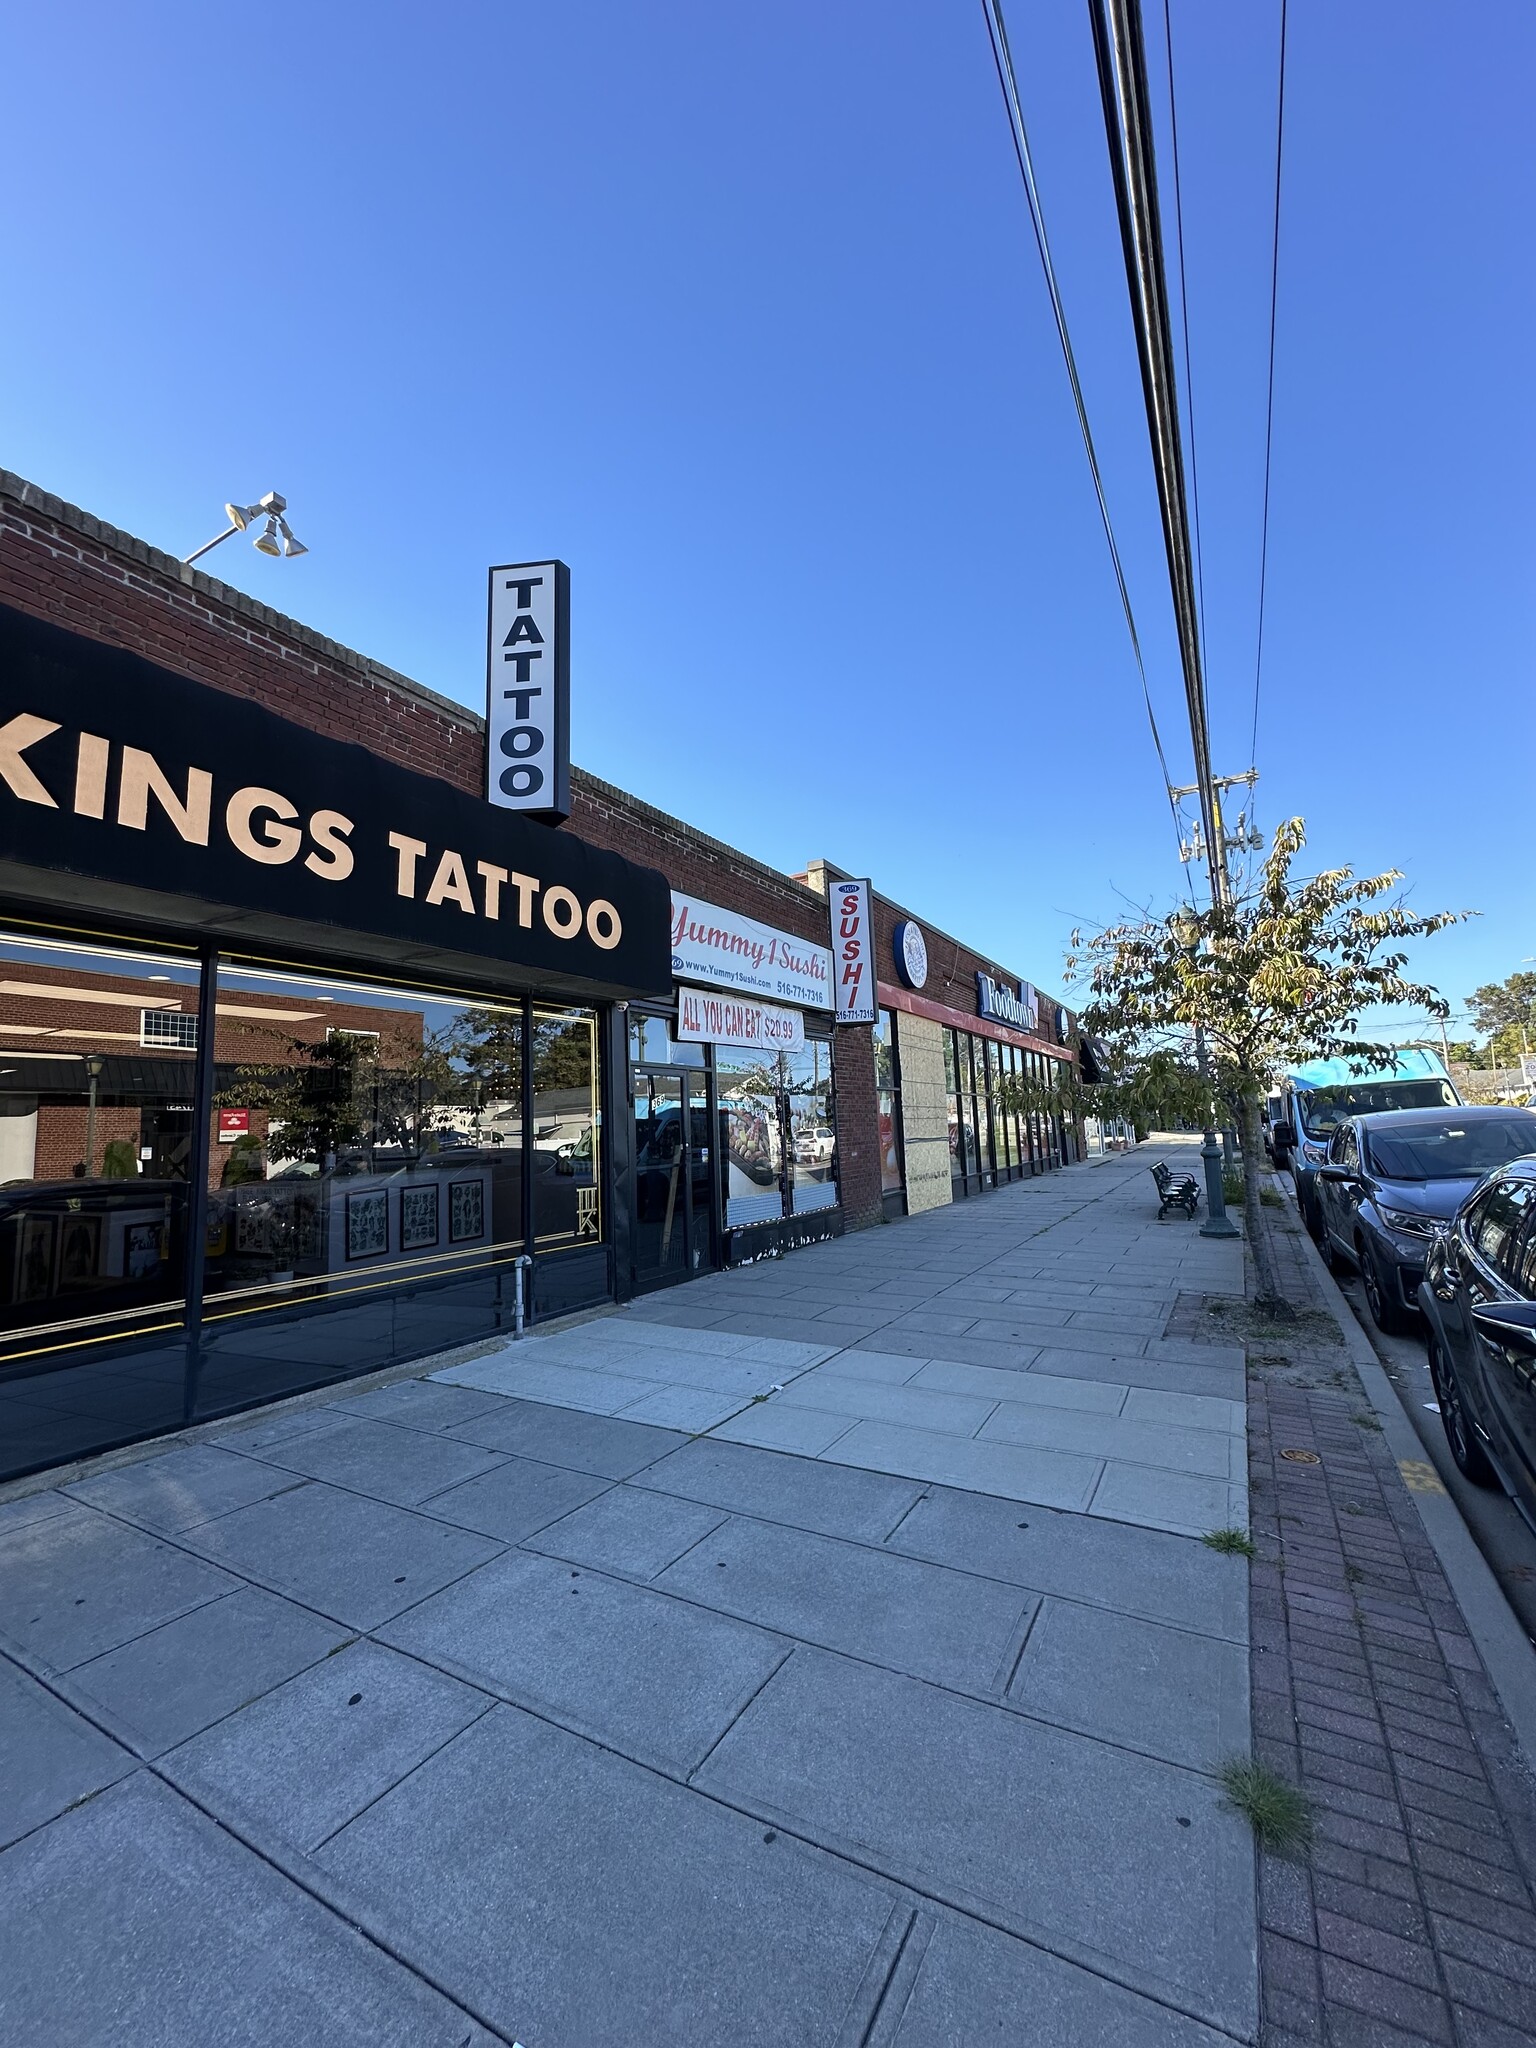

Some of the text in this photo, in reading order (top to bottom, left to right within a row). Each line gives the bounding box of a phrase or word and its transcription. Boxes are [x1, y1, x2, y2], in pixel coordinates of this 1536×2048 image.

[500, 577, 545, 797] TATTOO
[0, 713, 623, 950] KINGS TATTOO
[839, 894, 863, 1009] SUSHI
[686, 960, 771, 989] www.Yummy1Sushi.com
[777, 981, 823, 1004] 516-771-7316
[985, 975, 1035, 1030] Foodtown
[683, 997, 793, 1040] ALL YOU CAN EAT $20.99
[836, 1009, 874, 1020] 516-771-7316
[653, 1095, 664, 1109] 369
